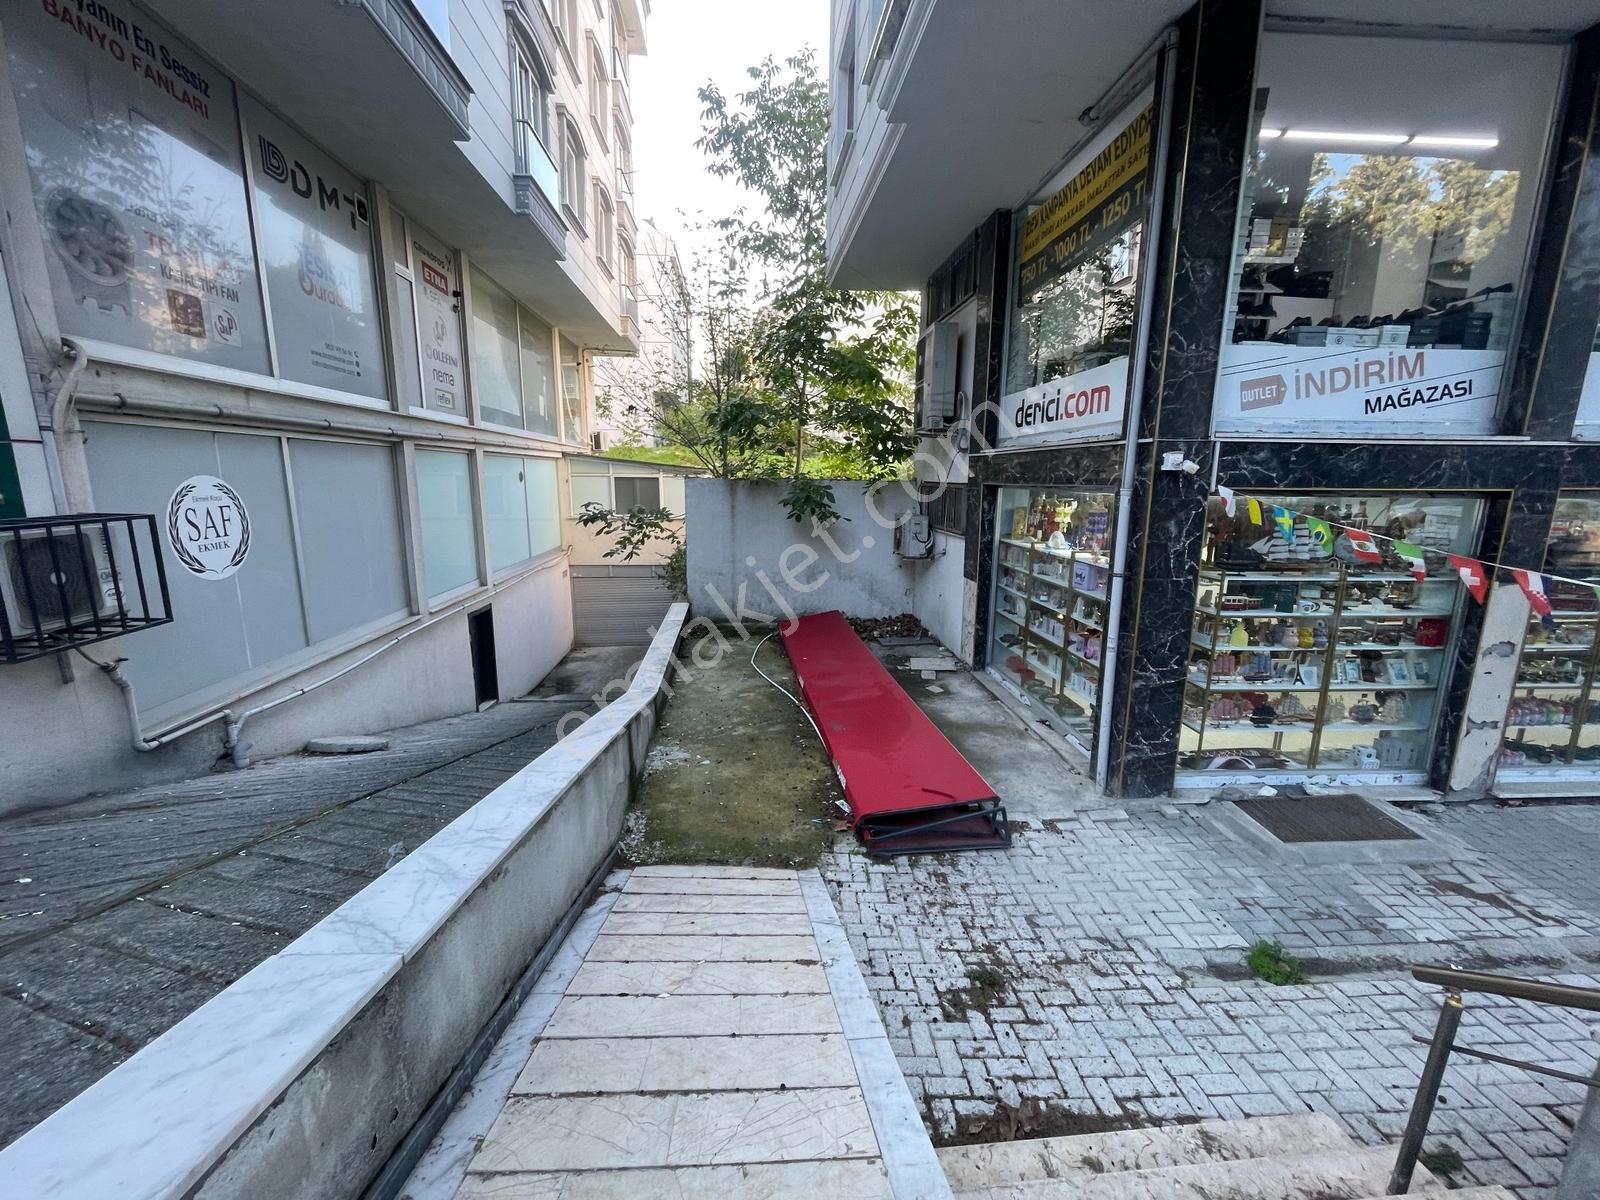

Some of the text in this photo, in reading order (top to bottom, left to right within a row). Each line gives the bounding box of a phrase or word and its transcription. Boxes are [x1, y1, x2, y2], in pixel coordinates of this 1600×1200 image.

[42, 0, 210, 120] BANYO FANLARI
[132, 24, 156, 61] En
[159, 44, 211, 99] Sessiz
[1079, 146, 1112, 189] DEVAM
[1038, 255, 1048, 275] TL
[1055, 232, 1076, 264] 1000
[1080, 222, 1092, 245] TL
[1102, 191, 1130, 229] 1250
[220, 285, 240, 304] FAN
[432, 368, 455, 387] nema
[1241, 384, 1278, 403] OUTLET
[1294, 350, 1426, 400] İNDİRİM
[1015, 384, 1111, 429] derici.com
[1364, 379, 1473, 415] MAĞAZASI
[184, 505, 232, 542] SAF
[198, 541, 231, 553] EKMEK
